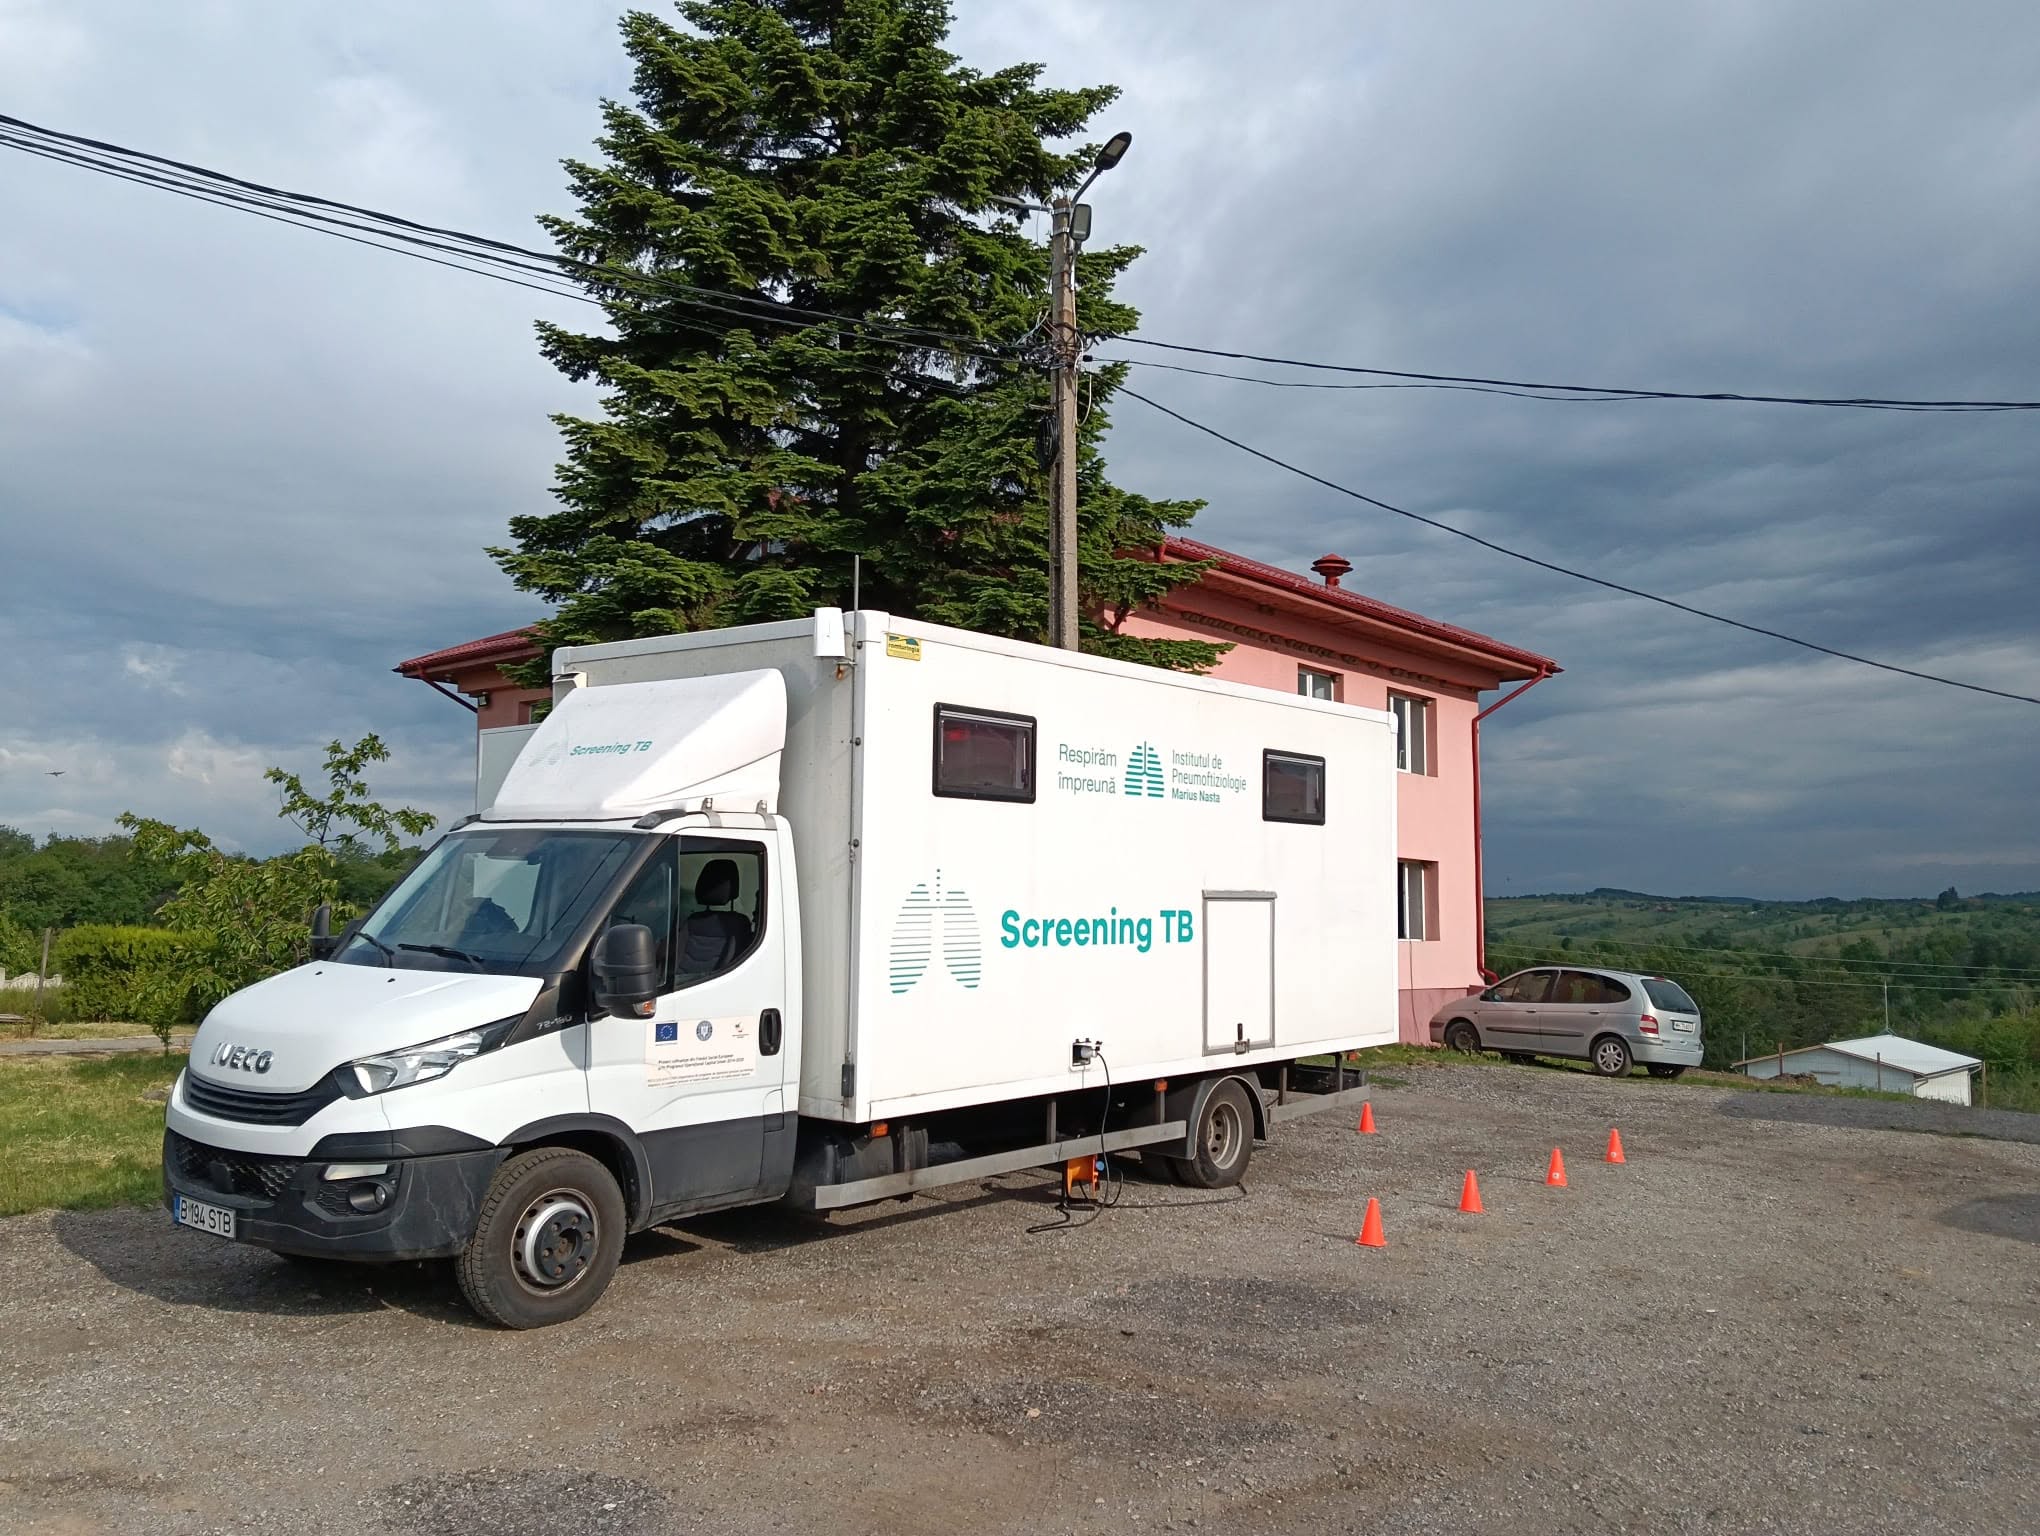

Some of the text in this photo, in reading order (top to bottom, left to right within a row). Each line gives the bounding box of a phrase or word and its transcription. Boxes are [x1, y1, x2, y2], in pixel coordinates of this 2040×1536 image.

[569, 741, 653, 756] Screening TB
[1059, 743, 1117, 768] Respirăm
[1172, 749, 1222, 770] Institutul de
[1058, 771, 1116, 796] împreună
[1172, 768, 1247, 793] Pneumoftiziologie
[1172, 787, 1221, 803] Marius Nasta
[1000, 906, 1194, 953] Screening TB
[211, 1042, 275, 1075] IVECO
[181, 1199, 231, 1233] B 194 STB
